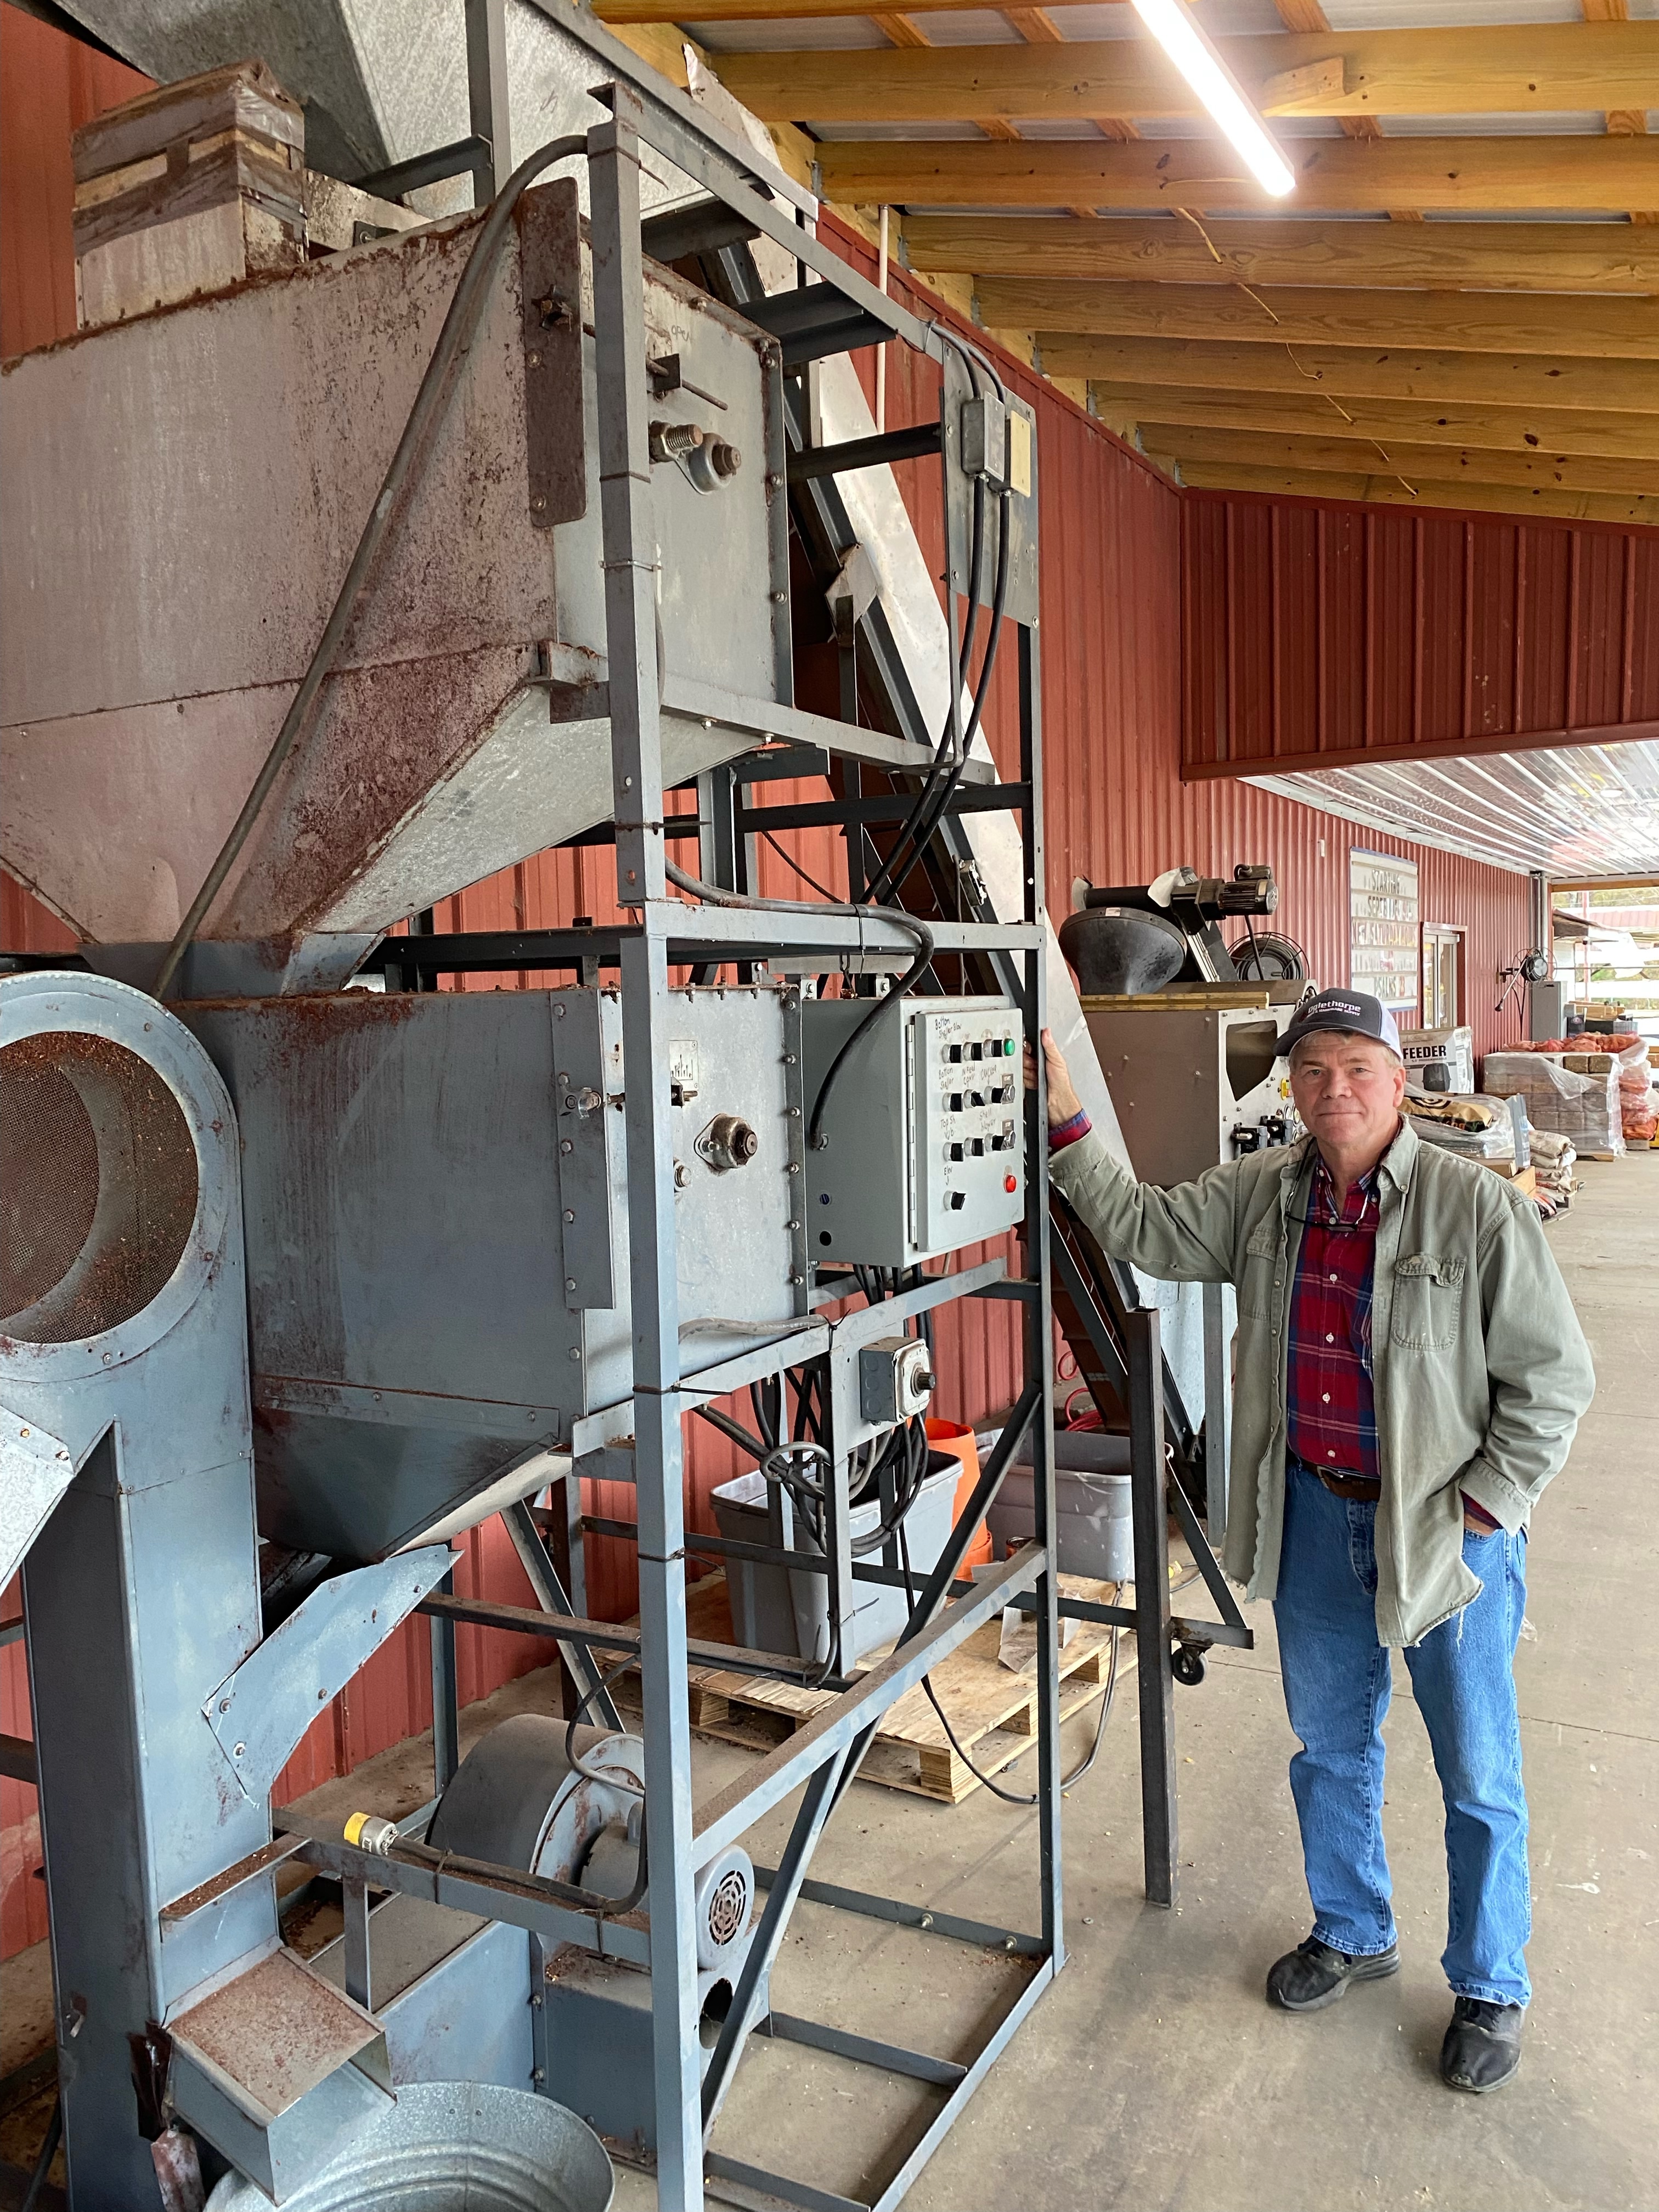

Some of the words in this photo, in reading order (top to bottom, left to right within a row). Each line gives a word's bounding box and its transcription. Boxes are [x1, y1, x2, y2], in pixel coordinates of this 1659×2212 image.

[1372, 869, 1400, 894] STARTING
[1308, 1000, 1361, 1014] Oglethorpe
[1402, 1045, 1447, 1059] FEEDER
[940, 1119, 949, 1131] Top
